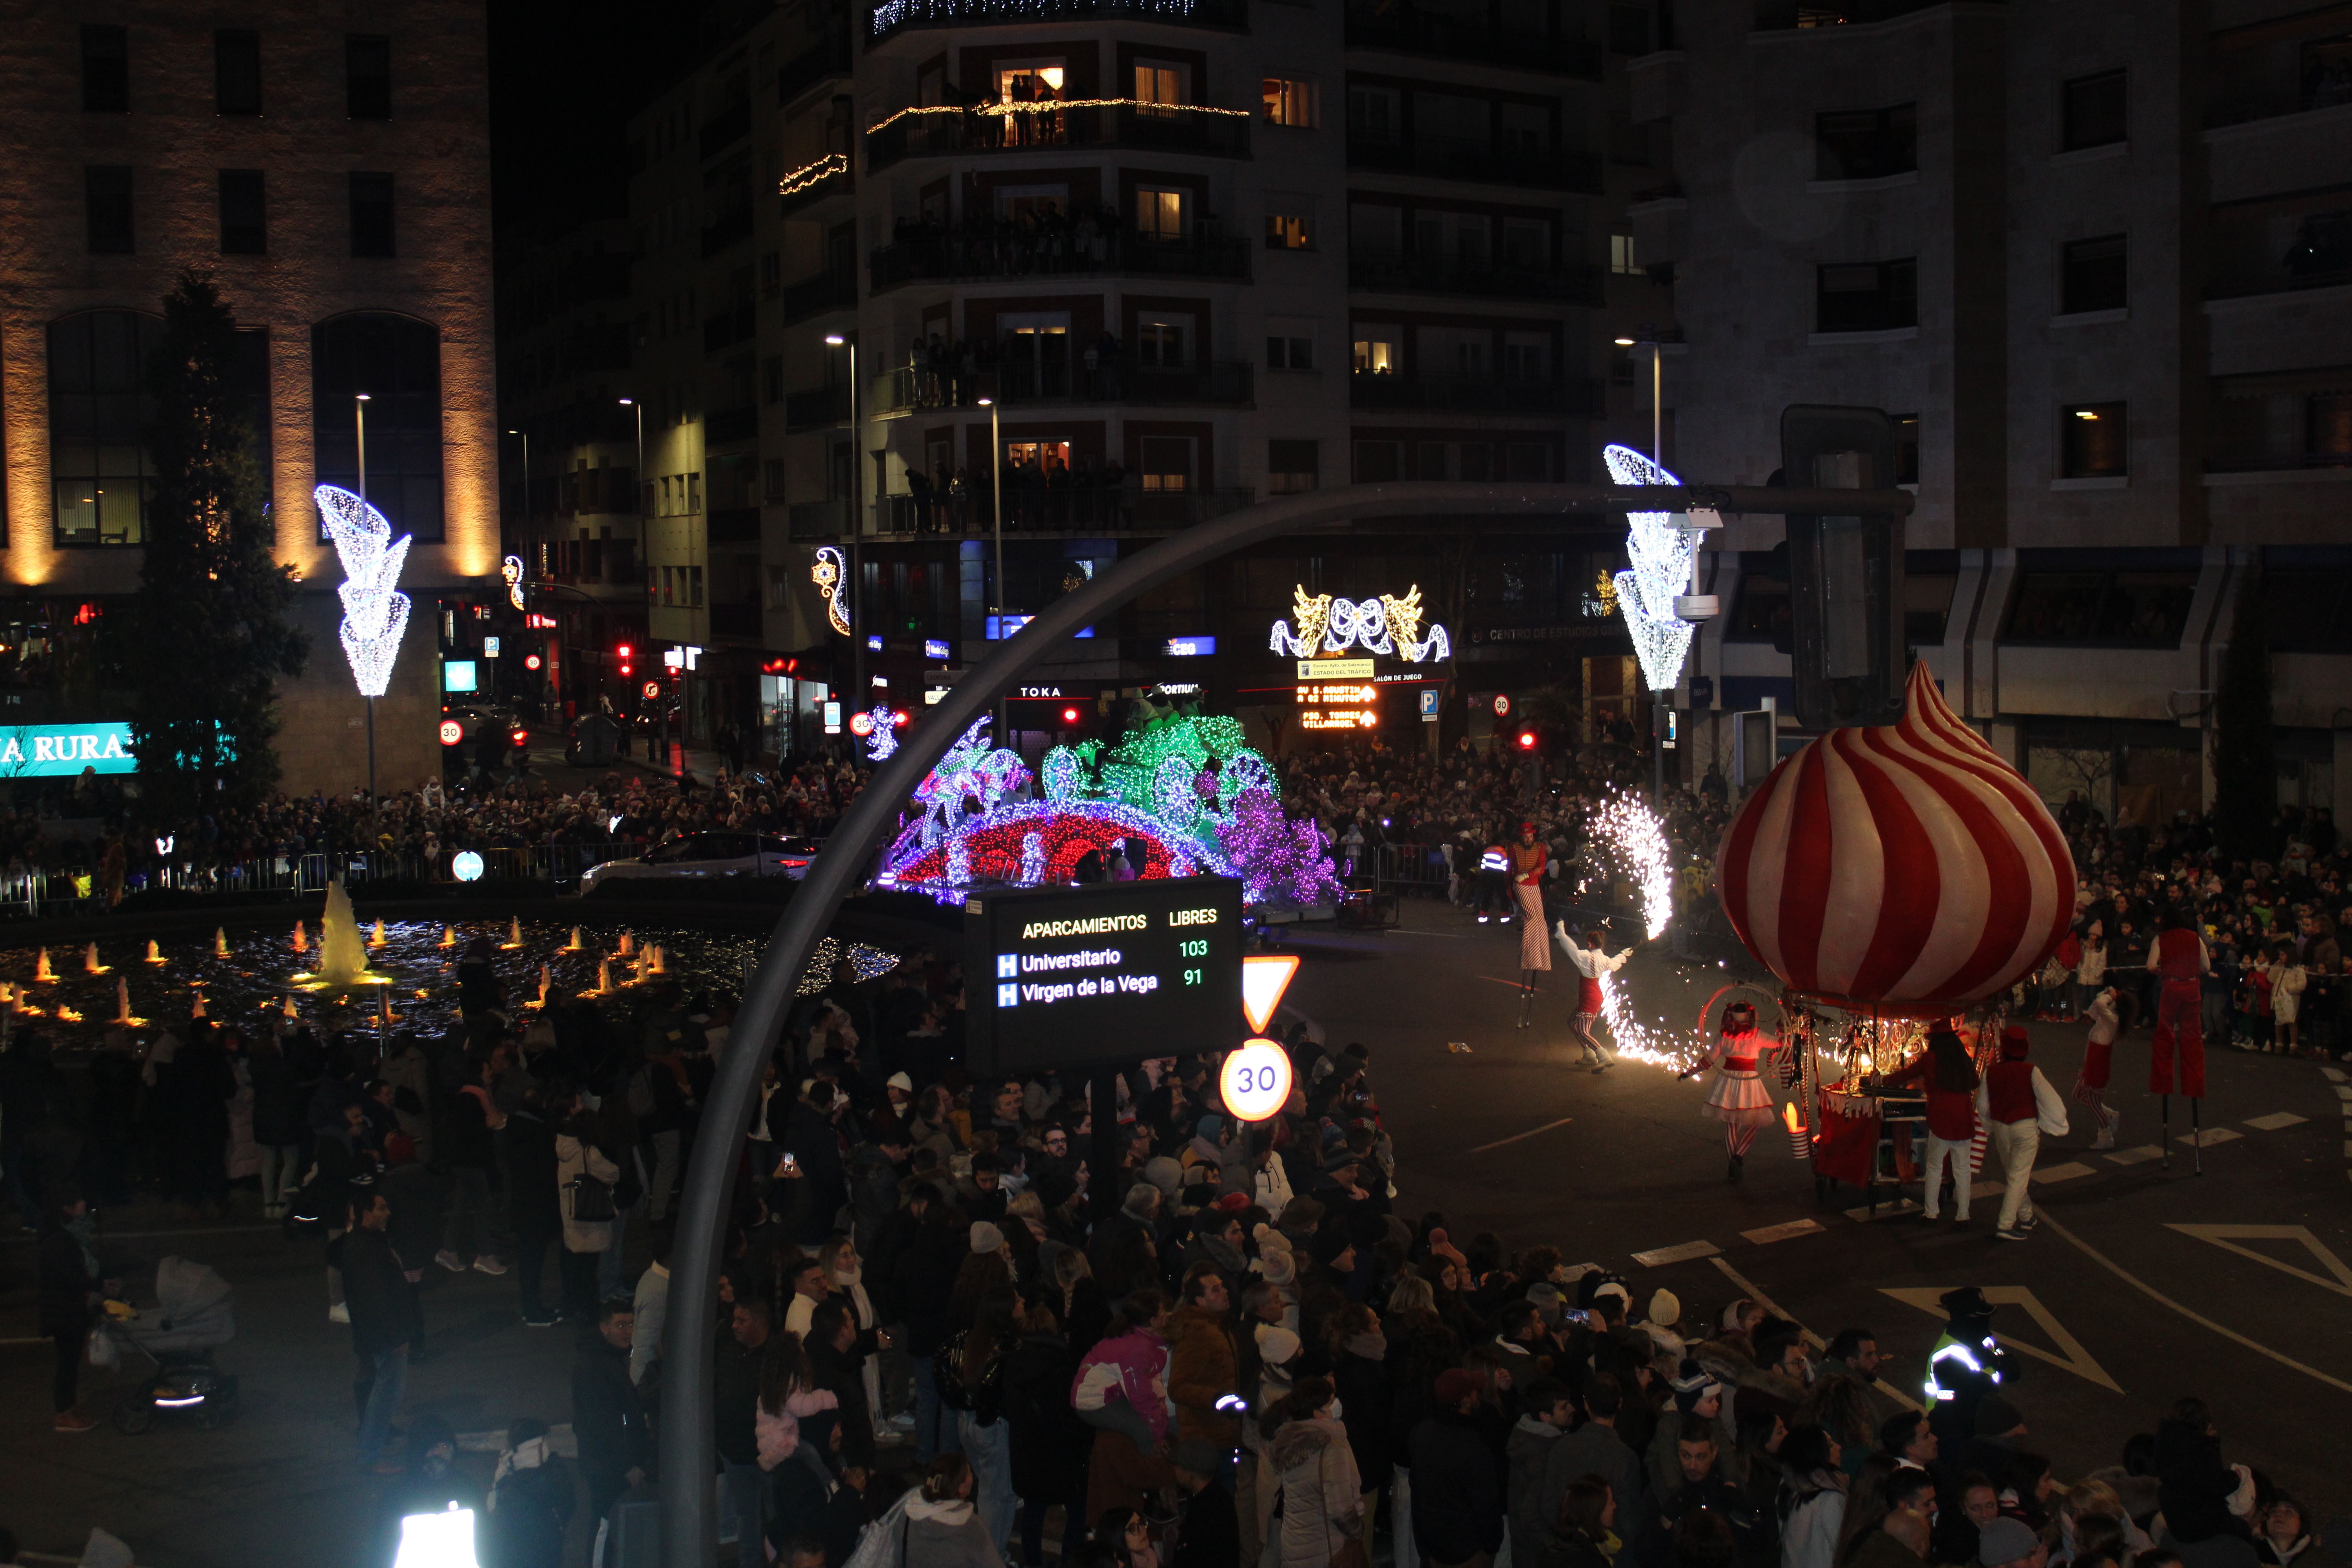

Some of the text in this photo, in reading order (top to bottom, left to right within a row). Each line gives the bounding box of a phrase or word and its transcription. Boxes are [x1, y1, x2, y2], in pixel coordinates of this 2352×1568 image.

[1490, 629, 1530, 640] CENTRO
[1534, 628, 1546, 638] DE
[1173, 643, 1196, 656] CEG
[1373, 674, 1392, 682] SALÓN
[1020, 687, 1061, 697] TOKA
[1297, 686, 1309, 694] AV
[1693, 688, 1708, 696] BBVA
[1297, 694, 1303, 702] A
[1323, 694, 1360, 702] MINUTOS
[1424, 693, 1434, 711] P
[1329, 711, 1360, 719] TORRES
[1303, 720, 1356, 729] VILLARROEL
[0, 737, 26, 762] A
[1022, 908, 1217, 939] APARCAMIENTOS LIBRES
[1022, 948, 1121, 972] Universitario
[1180, 940, 1208, 957] 103
[1022, 983, 1073, 1004] Virgen
[1077, 979, 1096, 996] de
[1100, 976, 1114, 994] la
[1118, 975, 1157, 995] Vega
[1184, 969, 1201, 985] 91
[1238, 1066, 1276, 1093] 30
